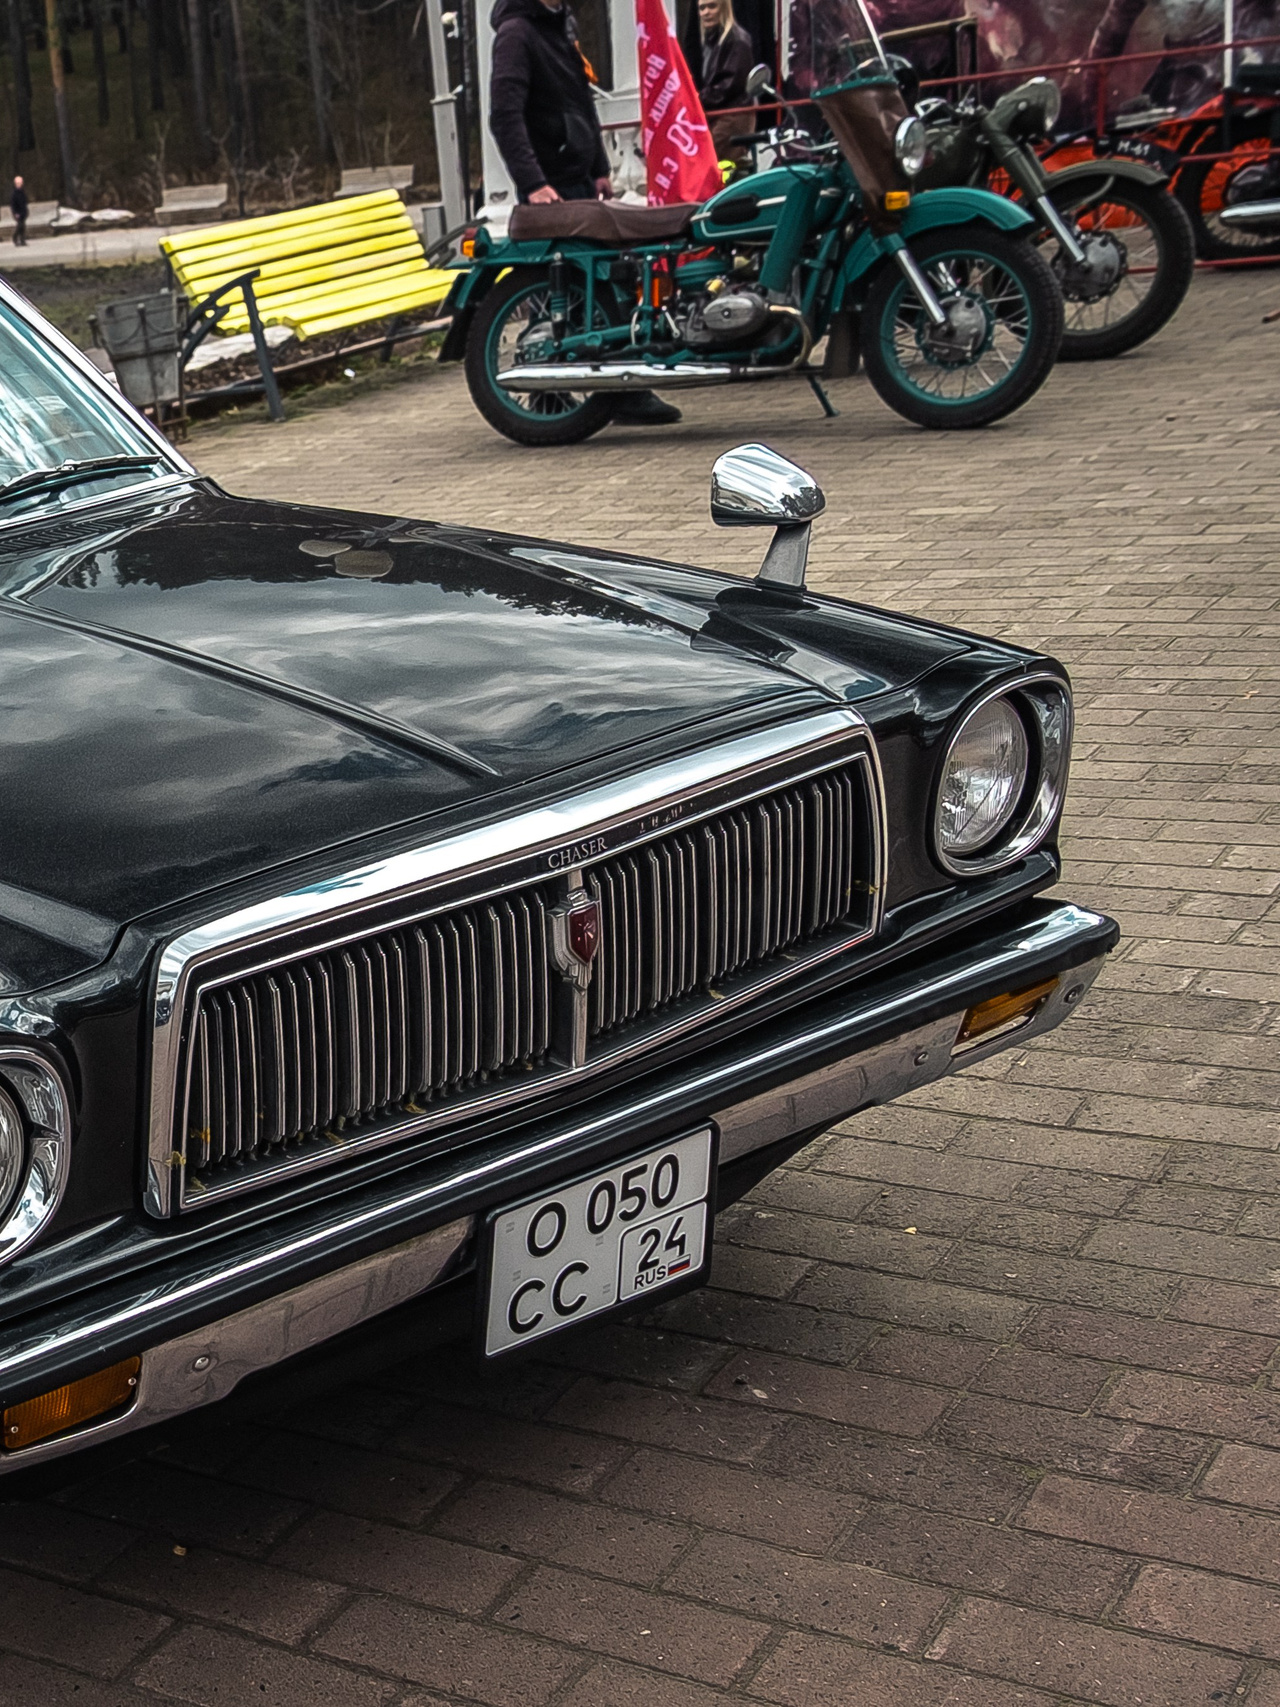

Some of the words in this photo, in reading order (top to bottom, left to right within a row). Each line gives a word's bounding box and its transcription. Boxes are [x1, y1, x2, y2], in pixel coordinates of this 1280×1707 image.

[547, 836, 608, 869] CHASER
[586, 1152, 680, 1235] 050
[637, 1216, 687, 1273] 24
[507, 1261, 590, 1335] CC
[634, 1266, 667, 1290] RUS
